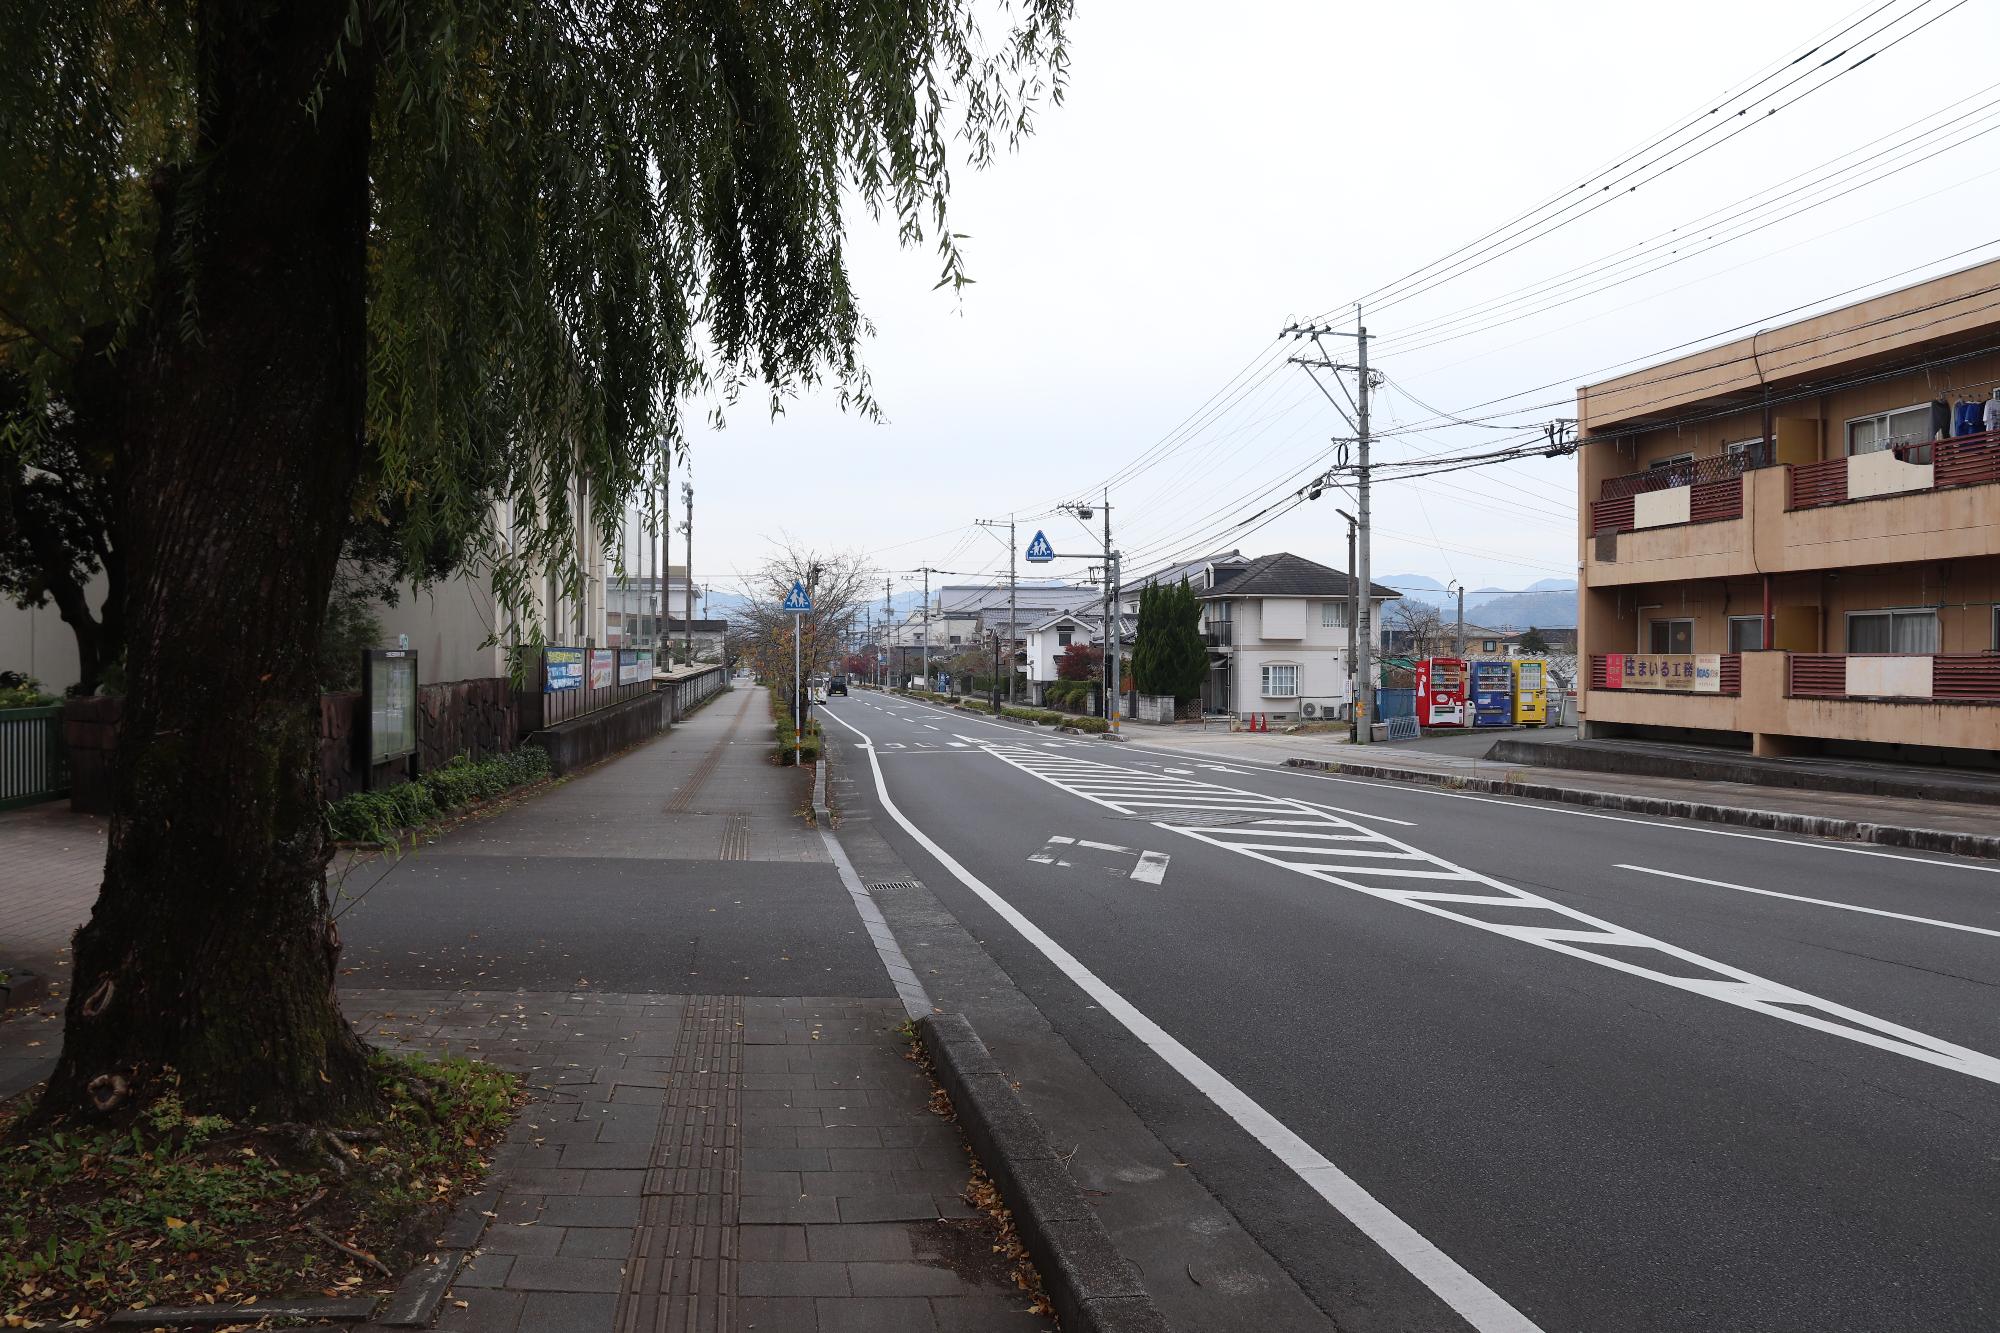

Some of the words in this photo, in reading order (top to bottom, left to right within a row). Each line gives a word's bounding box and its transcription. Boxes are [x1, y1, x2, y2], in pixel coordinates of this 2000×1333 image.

[1625, 656, 1694, 677] 住まいる工務
